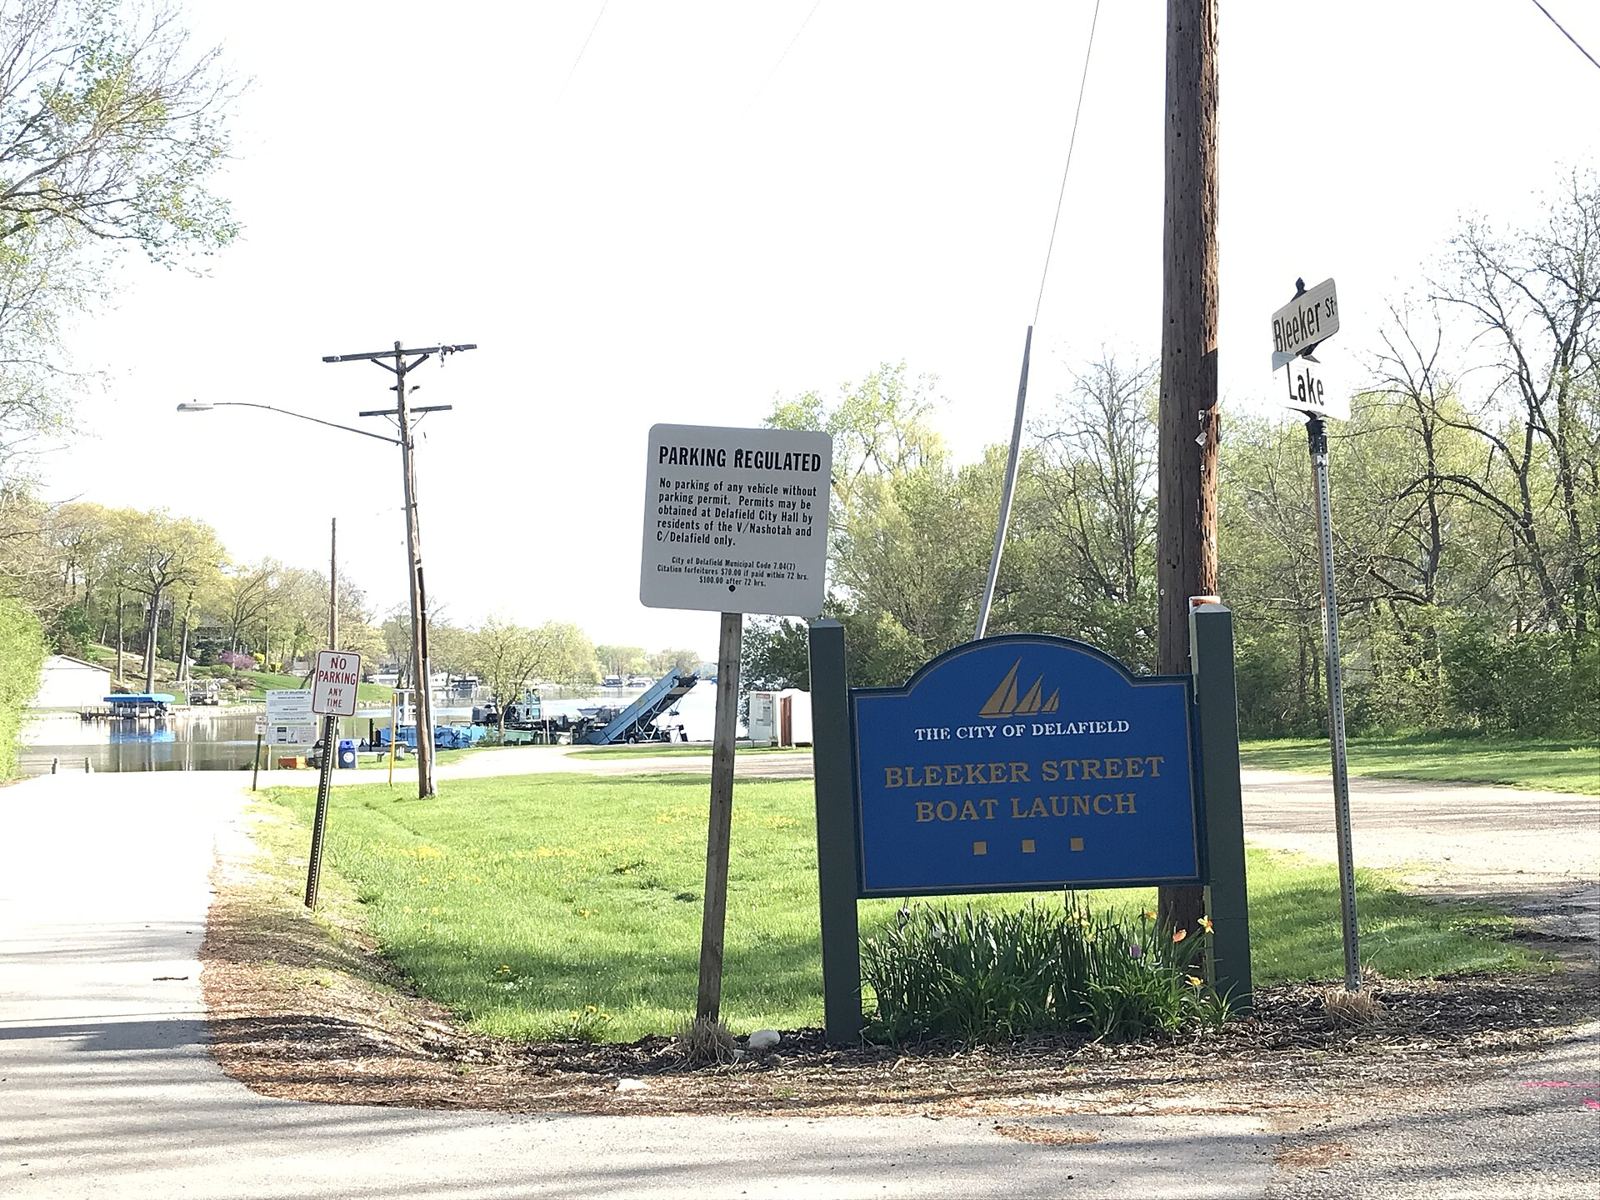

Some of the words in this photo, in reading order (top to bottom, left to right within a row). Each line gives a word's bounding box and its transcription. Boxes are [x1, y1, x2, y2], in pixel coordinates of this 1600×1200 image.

[1273, 302, 1320, 353] Bleeker
[1325, 297, 1335, 318] St
[1286, 362, 1324, 406] Lake
[659, 446, 726, 467] PARKING
[734, 449, 821, 472] REGULATED
[659, 478, 671, 488] No
[675, 479, 709, 492] parking
[713, 481, 723, 491] of
[727, 483, 743, 494] any
[747, 483, 778, 495] vehicle
[782, 485, 816, 497] without
[658, 492, 693, 504] parking
[697, 494, 731, 506] permit.
[738, 496, 774, 508] Permits
[778, 499, 797, 510] may
[800, 499, 811, 509] be
[658, 506, 697, 517] obtained
[701, 508, 711, 517] at
[715, 509, 755, 520] Delafield
[759, 510, 777, 522] City
[781, 512, 798, 522] Hall
[802, 513, 813, 524] by
[657, 519, 700, 530] residents
[704, 521, 714, 531] of
[718, 521, 732, 532] the
[737, 522, 792, 536] V/Nashotah
[795, 526, 812, 537] and
[656, 531, 710, 544] C/Delafield
[713, 534, 736, 547] only.
[657, 564, 682, 573] Citation
[684, 566, 718, 575] forfeitures
[751, 570, 764, 578] paid
[767, 570, 785, 578] within
[672, 556, 684, 565] City
[696, 557, 723, 566] Delafield
[725, 559, 754, 568] Municipal
[756, 561, 771, 569] Code
[726, 577, 741, 585] after
[744, 578, 751, 586] 72
[330, 658, 347, 670] NO
[318, 670, 356, 685] PARKING
[328, 687, 343, 697] ANY
[327, 699, 342, 708] TIME
[914, 727, 951, 741] THE
[956, 725, 996, 739] CITY
[1002, 723, 1026, 737] OF
[1032, 720, 1130, 737] DELAFIELD
[884, 762, 1031, 788] BLEEKER
[1041, 756, 1164, 782] STREET
[915, 799, 998, 823] BOAT
[1011, 793, 1137, 818] LAUNCH
